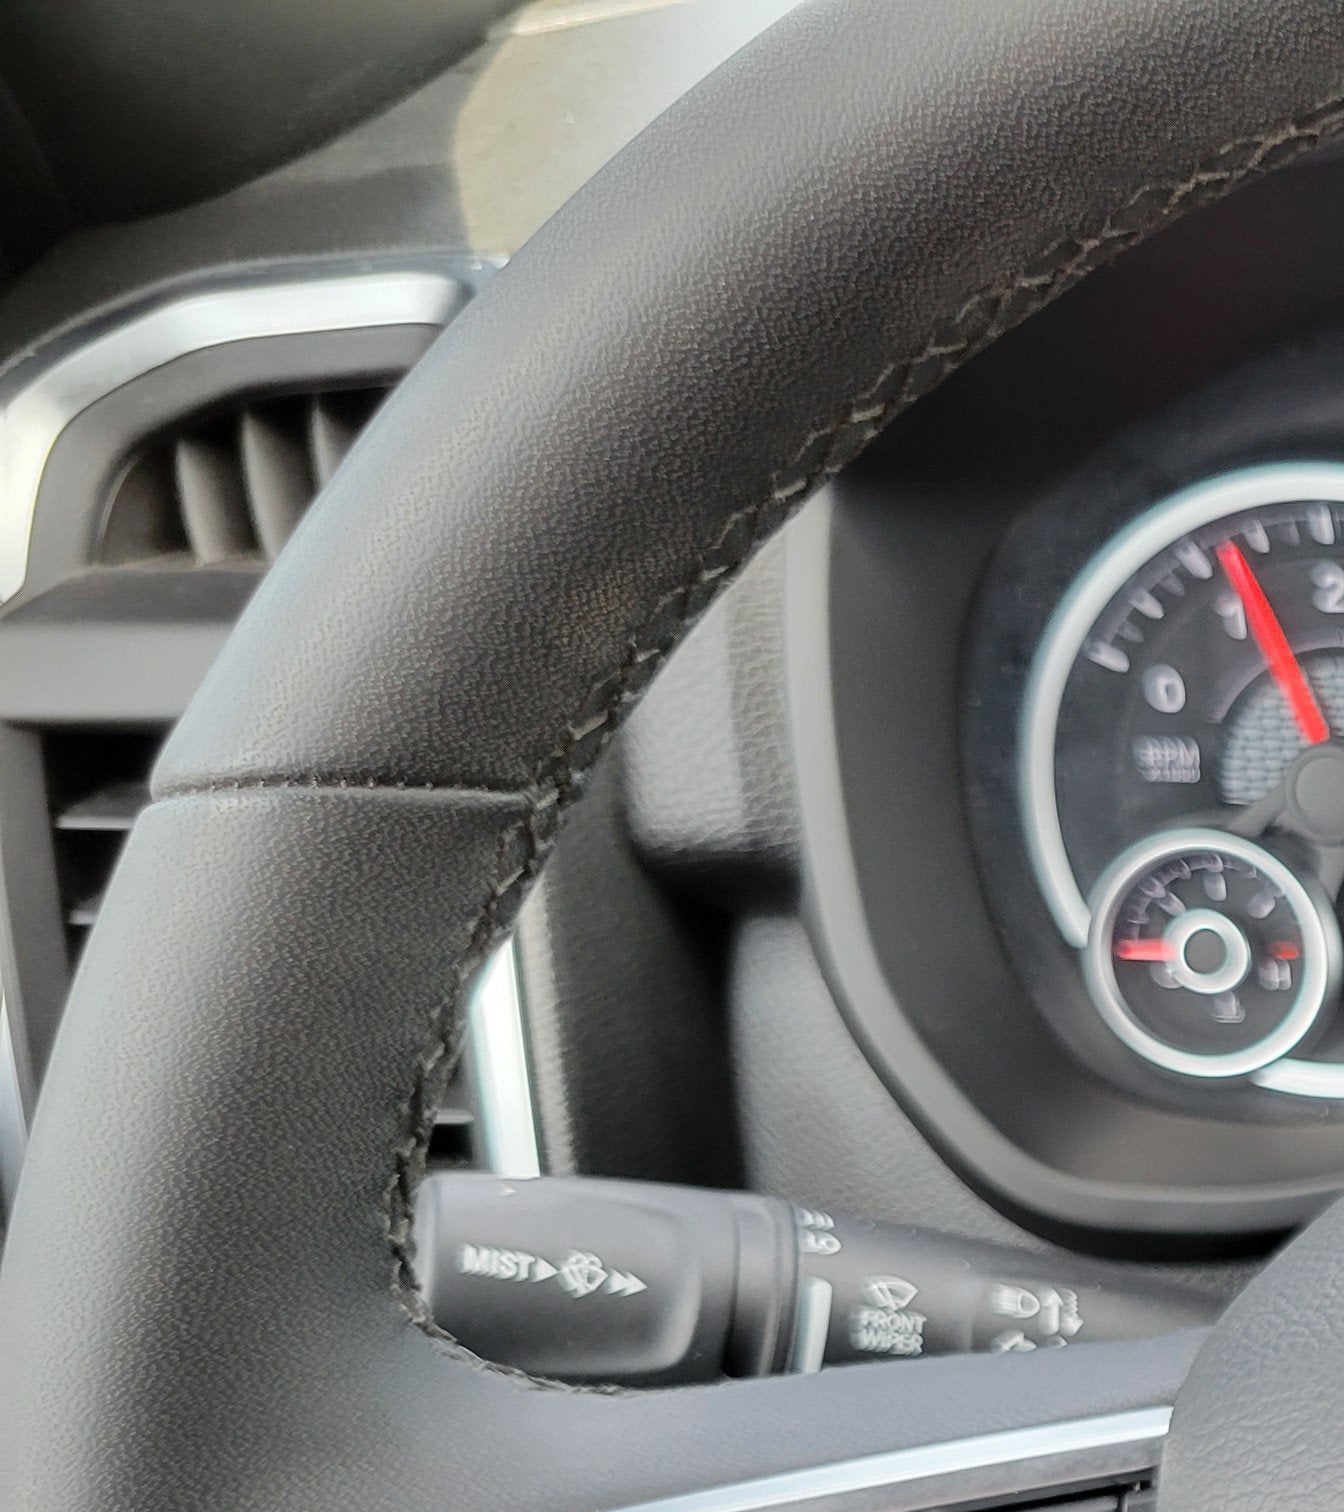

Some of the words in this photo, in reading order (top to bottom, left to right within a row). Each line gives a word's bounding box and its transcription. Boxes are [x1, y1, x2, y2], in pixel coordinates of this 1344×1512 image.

[1213, 592, 1248, 640] 1
[1142, 664, 1186, 713] 0
[461, 1244, 535, 1282] MIST
[855, 1308, 927, 1334] FRONT
